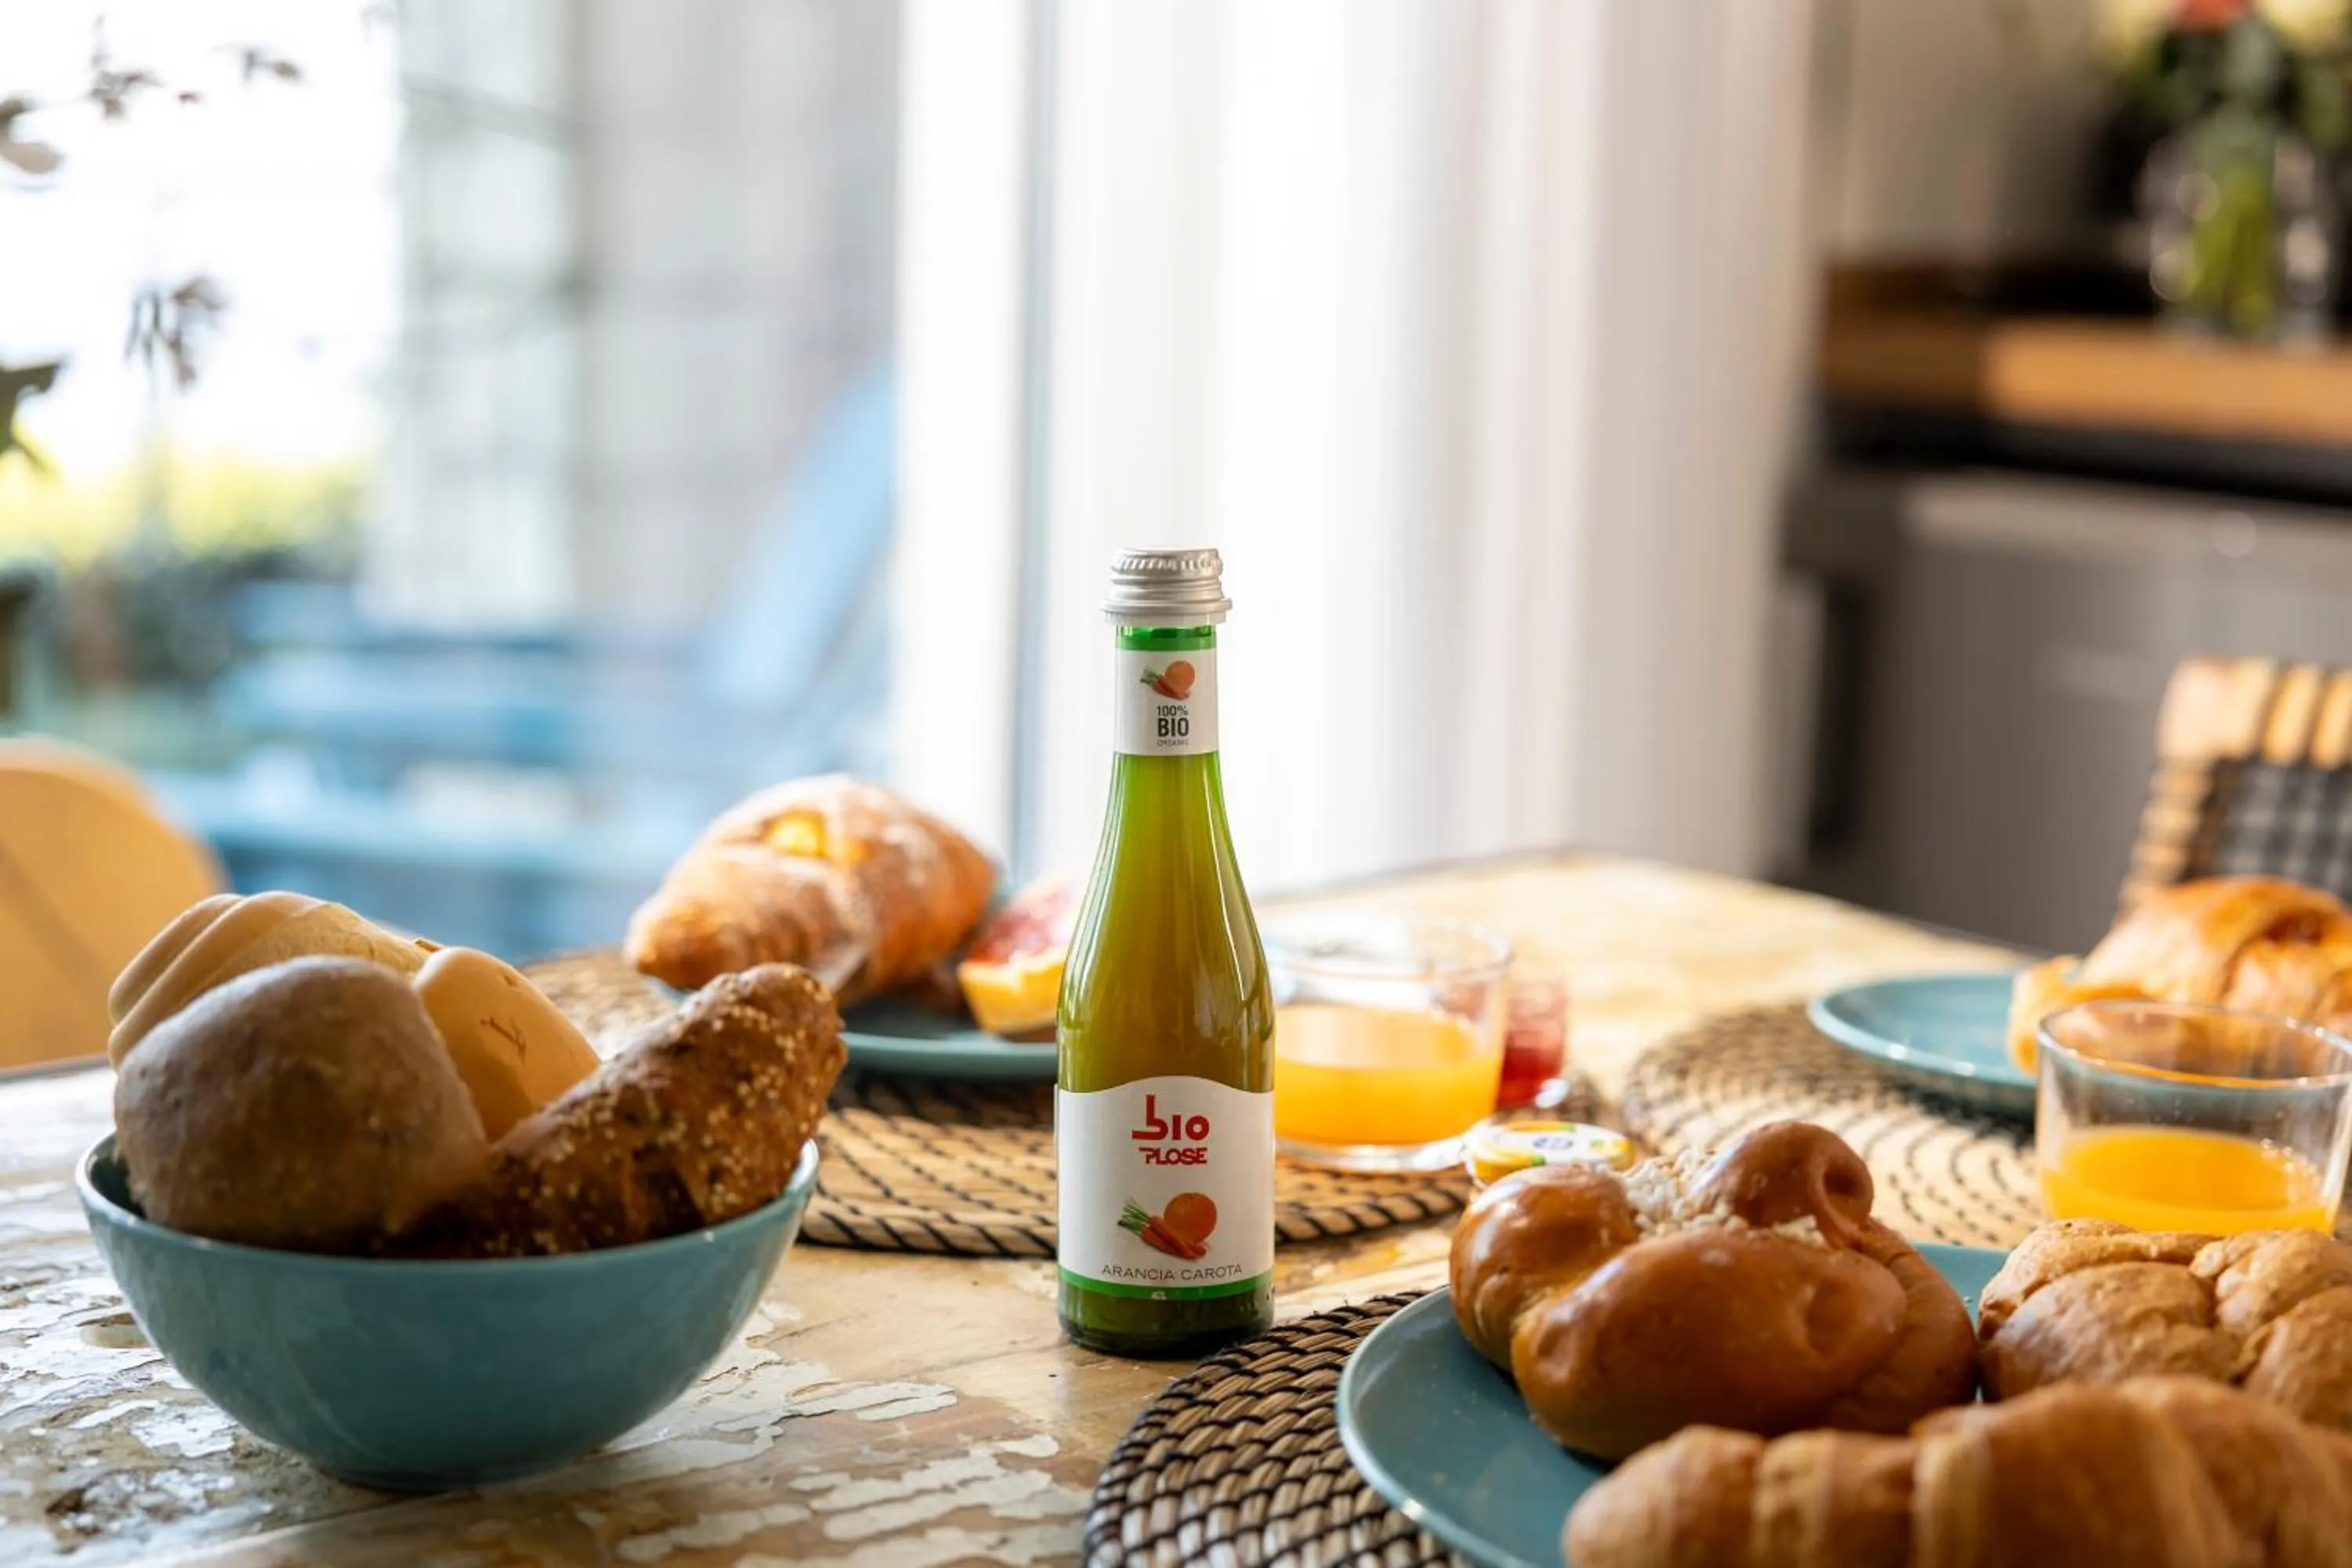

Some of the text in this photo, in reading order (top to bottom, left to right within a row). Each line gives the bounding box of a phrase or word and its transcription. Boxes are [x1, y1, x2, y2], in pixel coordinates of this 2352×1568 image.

[1156, 705, 1189, 717] 100%
[1158, 718, 1189, 736] BIO
[1132, 1094, 1210, 1141] bio
[1139, 1147, 1207, 1165] PLOSE
[1102, 1264, 1243, 1280] ARANCIA CAROTA
